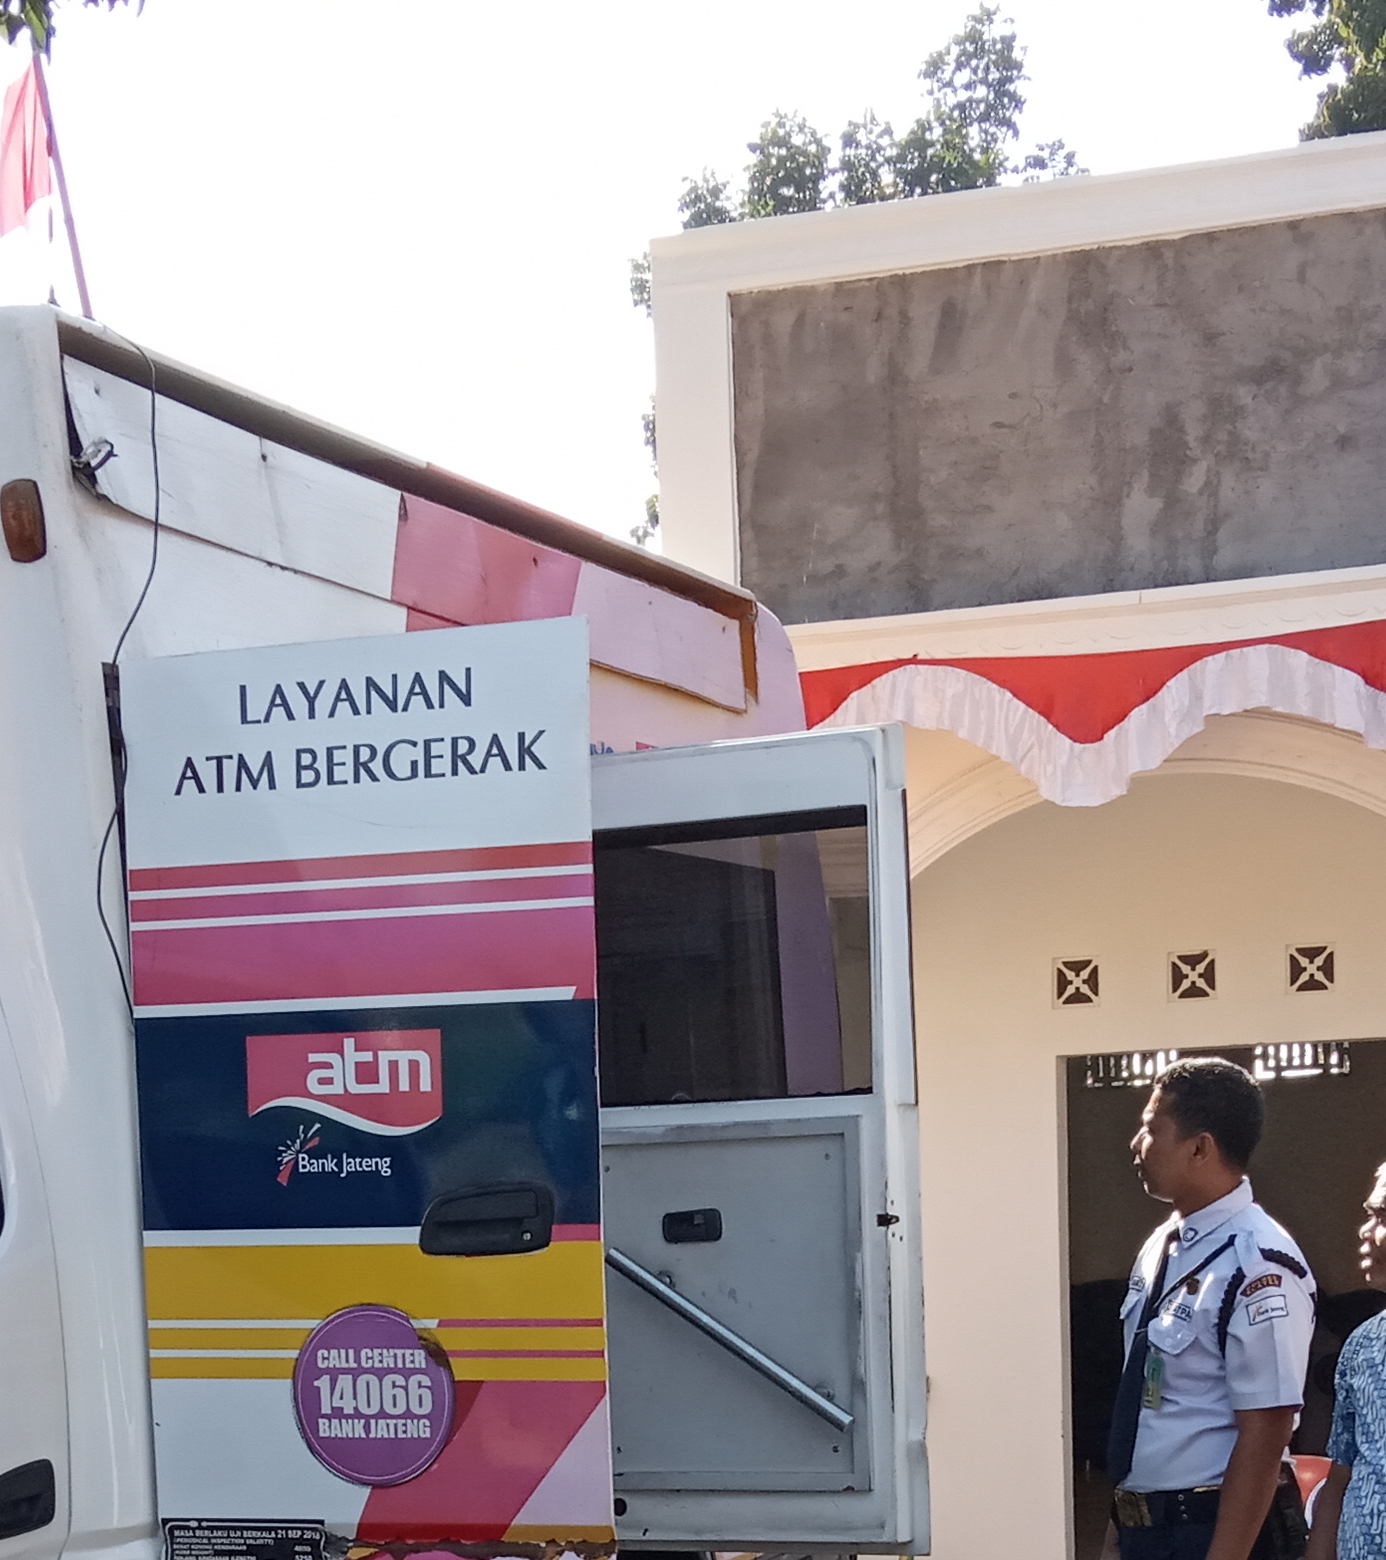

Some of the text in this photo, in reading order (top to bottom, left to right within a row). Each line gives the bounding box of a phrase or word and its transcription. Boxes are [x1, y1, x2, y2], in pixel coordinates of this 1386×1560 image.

[238, 666, 473, 726] LAYANAN
[174, 729, 548, 796] ATM BERGERAK
[305, 1037, 432, 1095] atm
[298, 1152, 391, 1177] Bank Jateng
[316, 1348, 426, 1368] CALL CENTER
[313, 1374, 433, 1415] 14066
[318, 1417, 431, 1438] BANK JATENG
